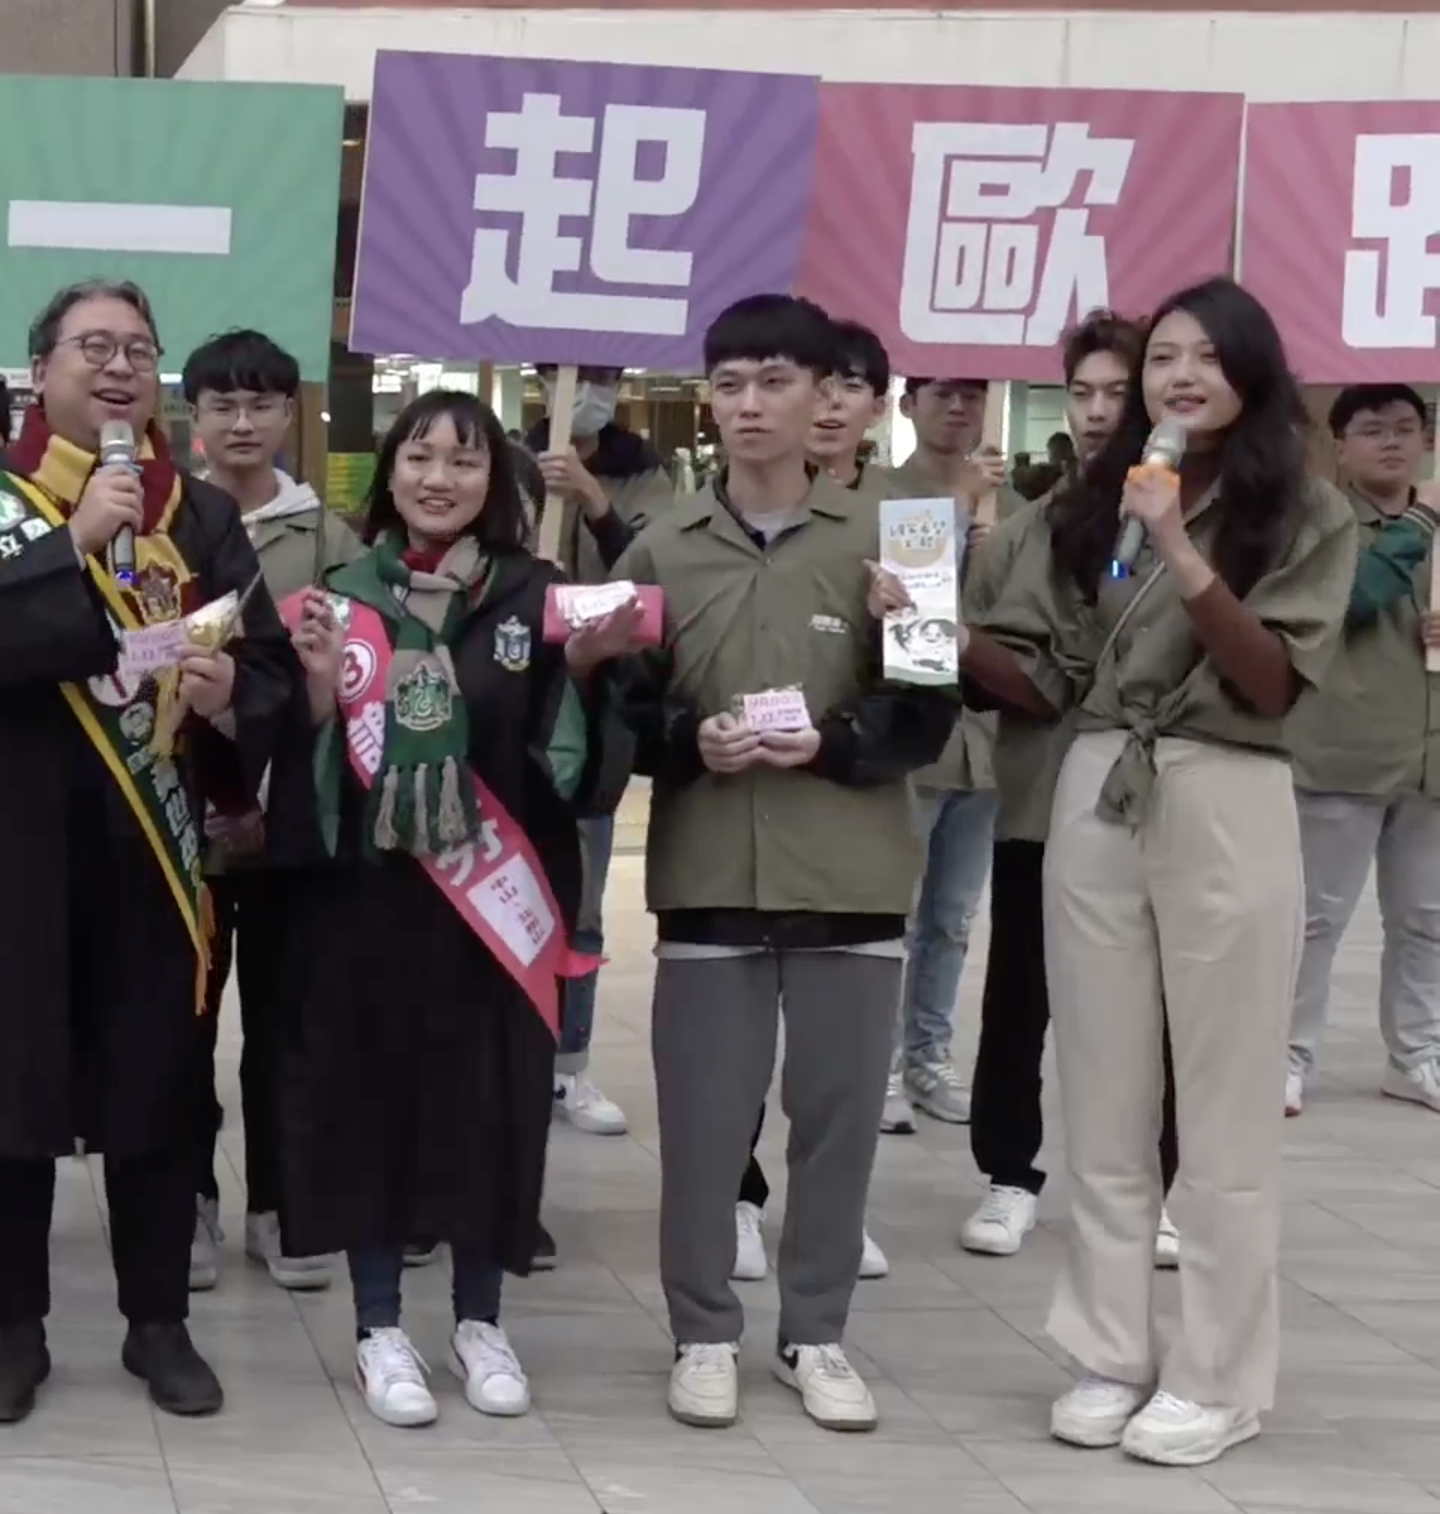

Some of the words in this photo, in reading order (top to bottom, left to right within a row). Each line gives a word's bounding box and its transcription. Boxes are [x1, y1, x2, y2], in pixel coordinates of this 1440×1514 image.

[6, 199, 233, 255] 一
[459, 92, 707, 336] 起
[898, 121, 1136, 348] 歐
